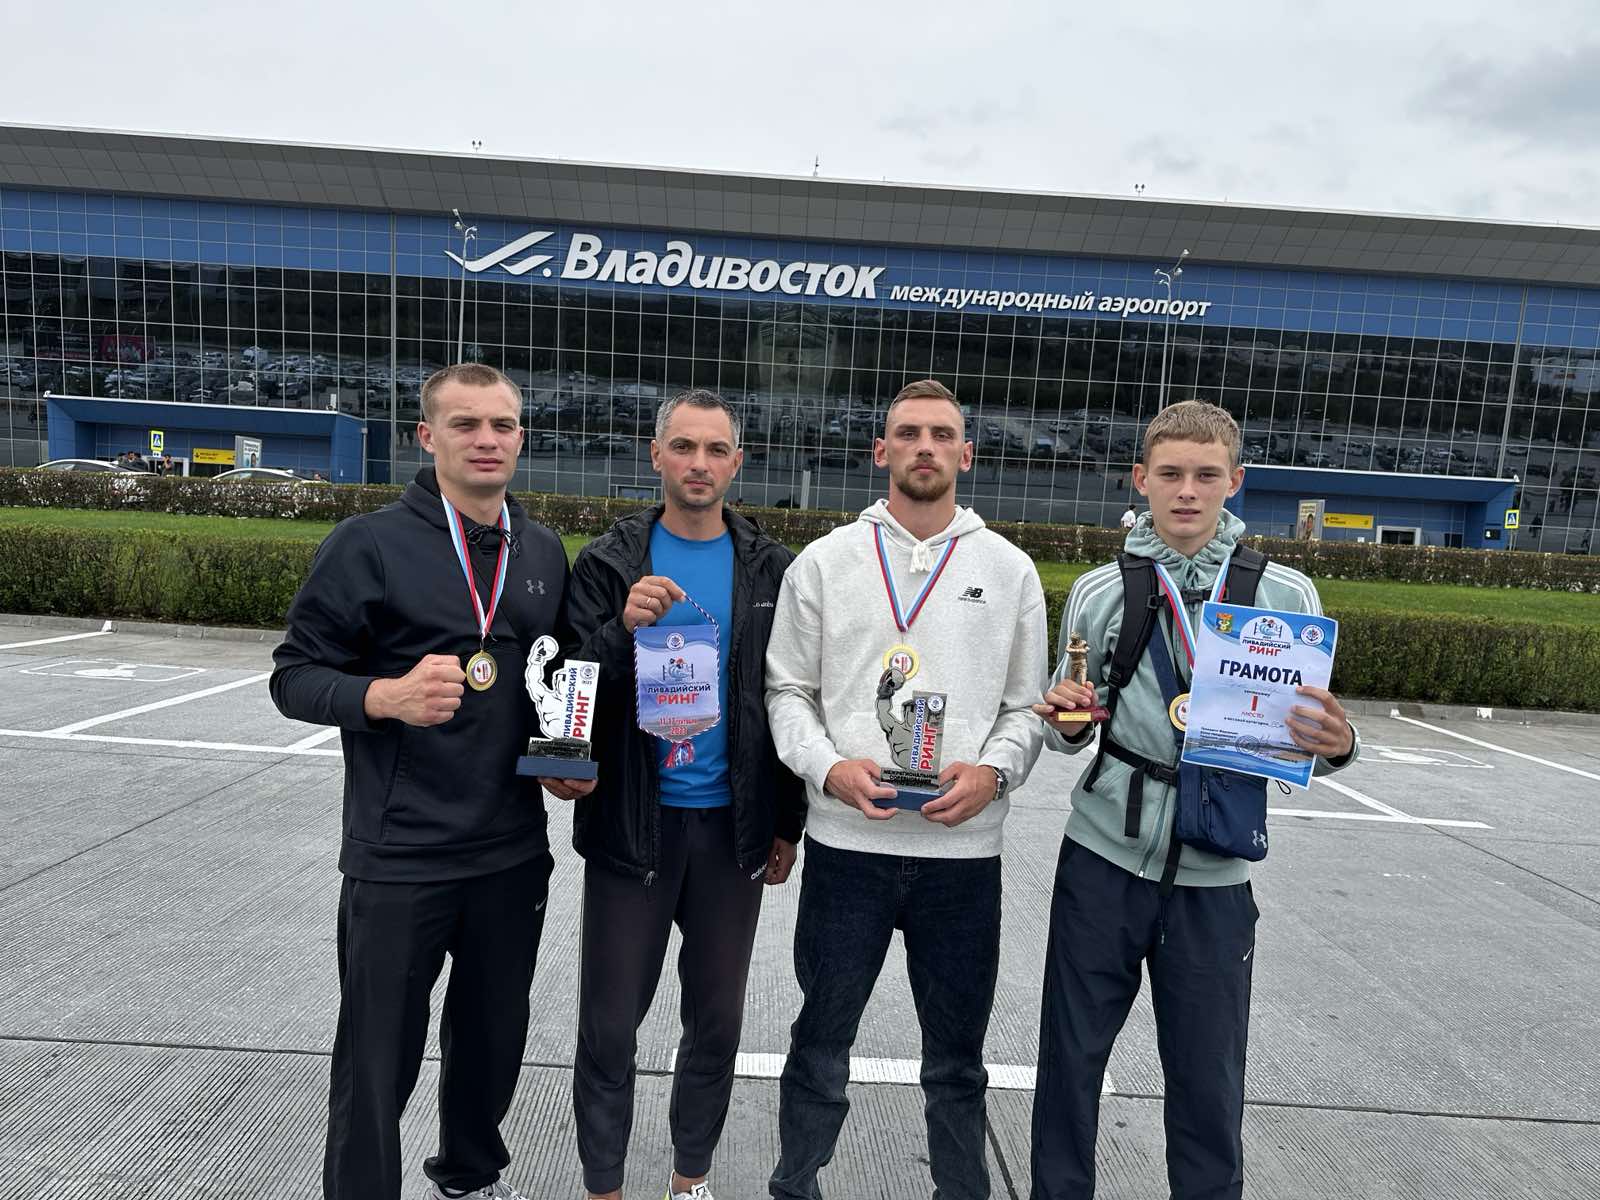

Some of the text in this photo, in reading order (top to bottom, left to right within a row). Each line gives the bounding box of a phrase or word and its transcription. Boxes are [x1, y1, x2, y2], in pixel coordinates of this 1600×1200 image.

[561, 233, 1212, 320] Владивосток международный аэропорт
[1242, 639, 1291, 650] ЛИВАДИЙСКИЙ
[1248, 645, 1282, 657] РИНГ
[647, 683, 711, 694] ЛИВАДИЙСКИЙ
[1219, 659, 1303, 686] ГРАМОТА
[563, 667, 578, 738] ЛИВАДИЙСКИЙ
[573, 690, 590, 739] РИНГ
[657, 693, 699, 705] РИНГ
[910, 698, 926, 769] ЛИВАДИЙСКИЙ
[920, 722, 938, 771] РИНГ
